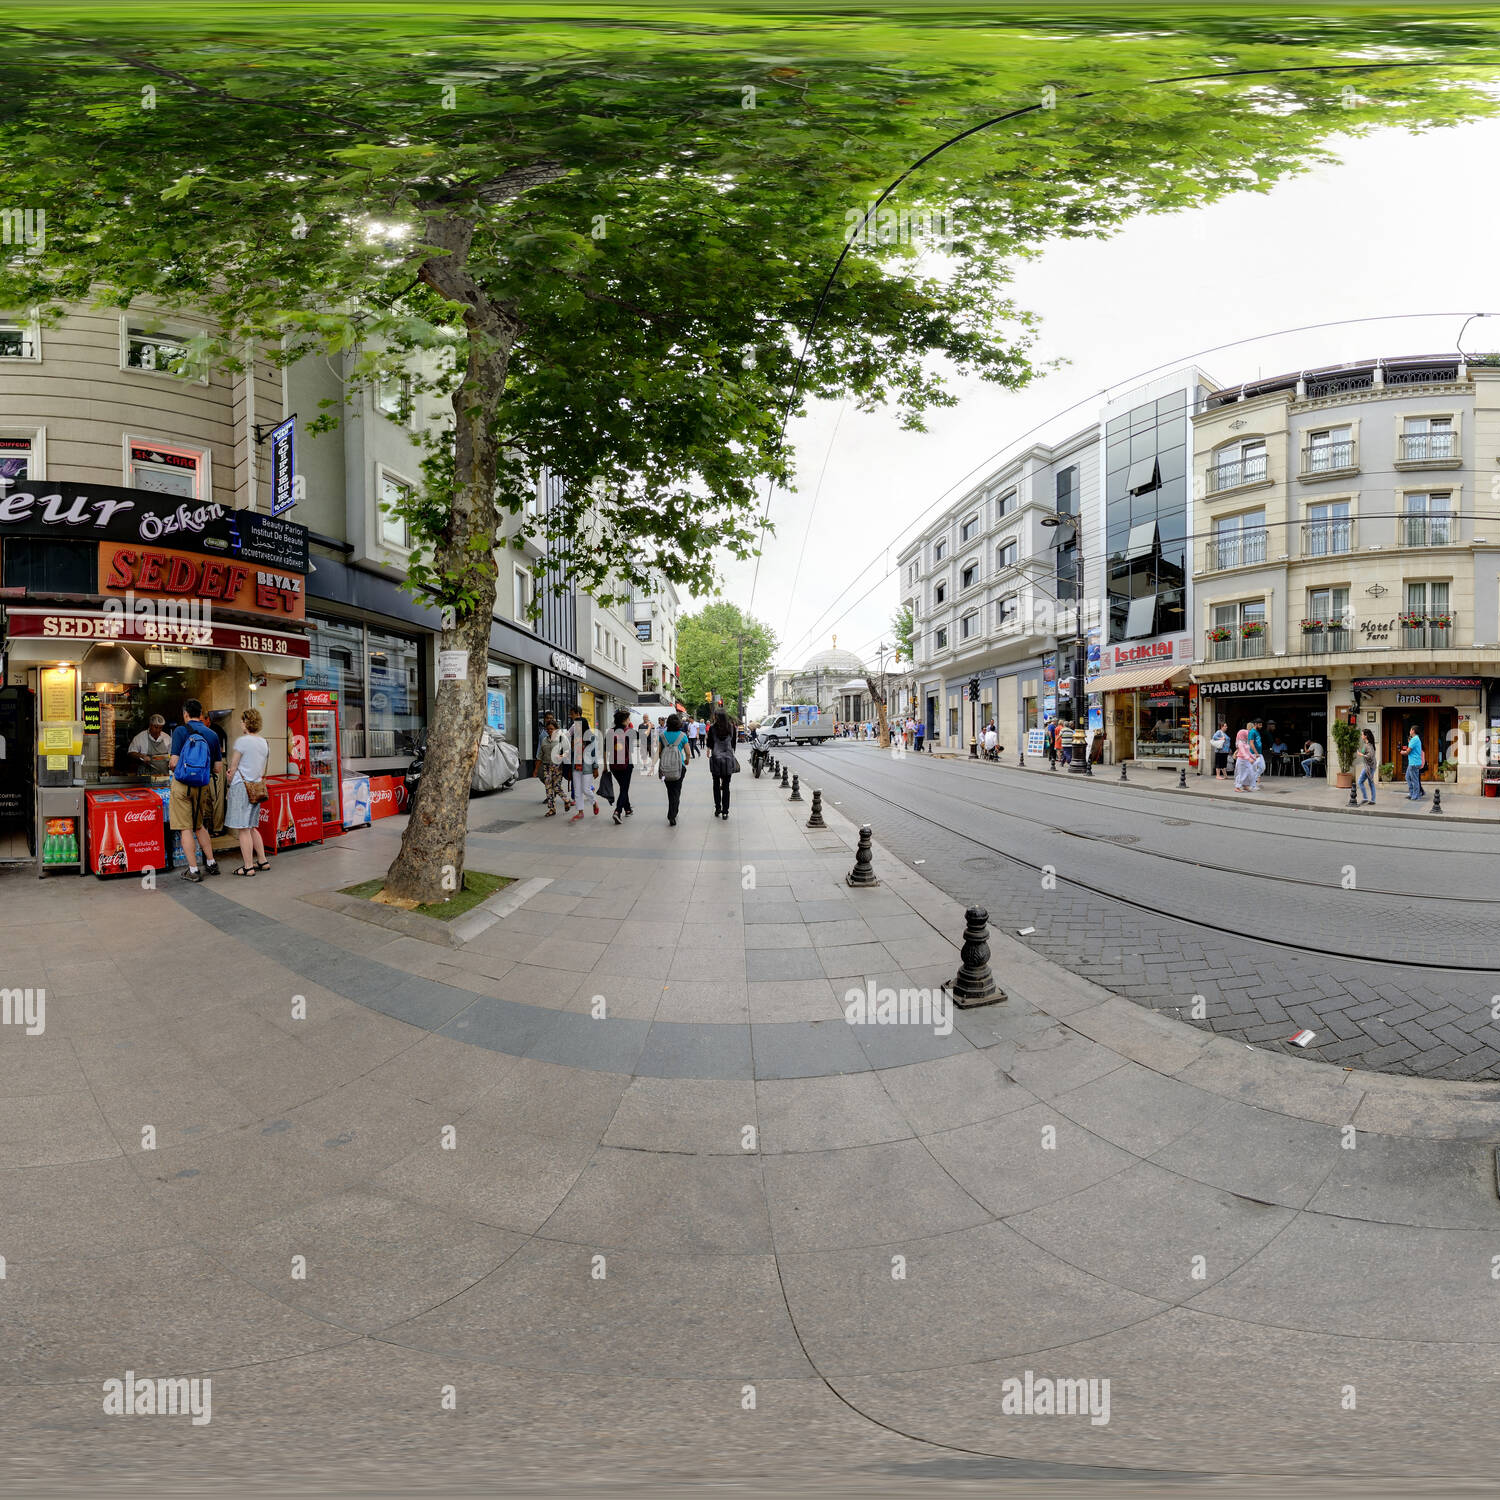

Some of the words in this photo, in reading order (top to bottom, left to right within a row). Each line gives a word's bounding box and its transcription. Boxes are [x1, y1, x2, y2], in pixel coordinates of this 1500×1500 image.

[139, 503, 225, 541] Özkan
[262, 517, 284, 532] Beauty
[285, 523, 304, 536] Parlor
[251, 525, 273, 539] Institut
[274, 531, 283, 541] De
[107, 549, 249, 602] SEDEF
[256, 571, 301, 593] BEYAZ
[256, 585, 299, 612] ET
[1360, 619, 1396, 633] Hotel
[43, 617, 125, 640] SEDEF
[143, 623, 214, 646] BEYAZ
[240, 634, 259, 651] 516
[261, 637, 273, 652] 59
[275, 639, 288, 655] 30
[1366, 631, 1388, 641] Faros
[1200, 680, 1271, 695] STARBUCKS
[1273, 677, 1324, 691] COFFEE
[294, 790, 316, 802] Coca-Cola
[124, 808, 157, 823] Coca-Cola
